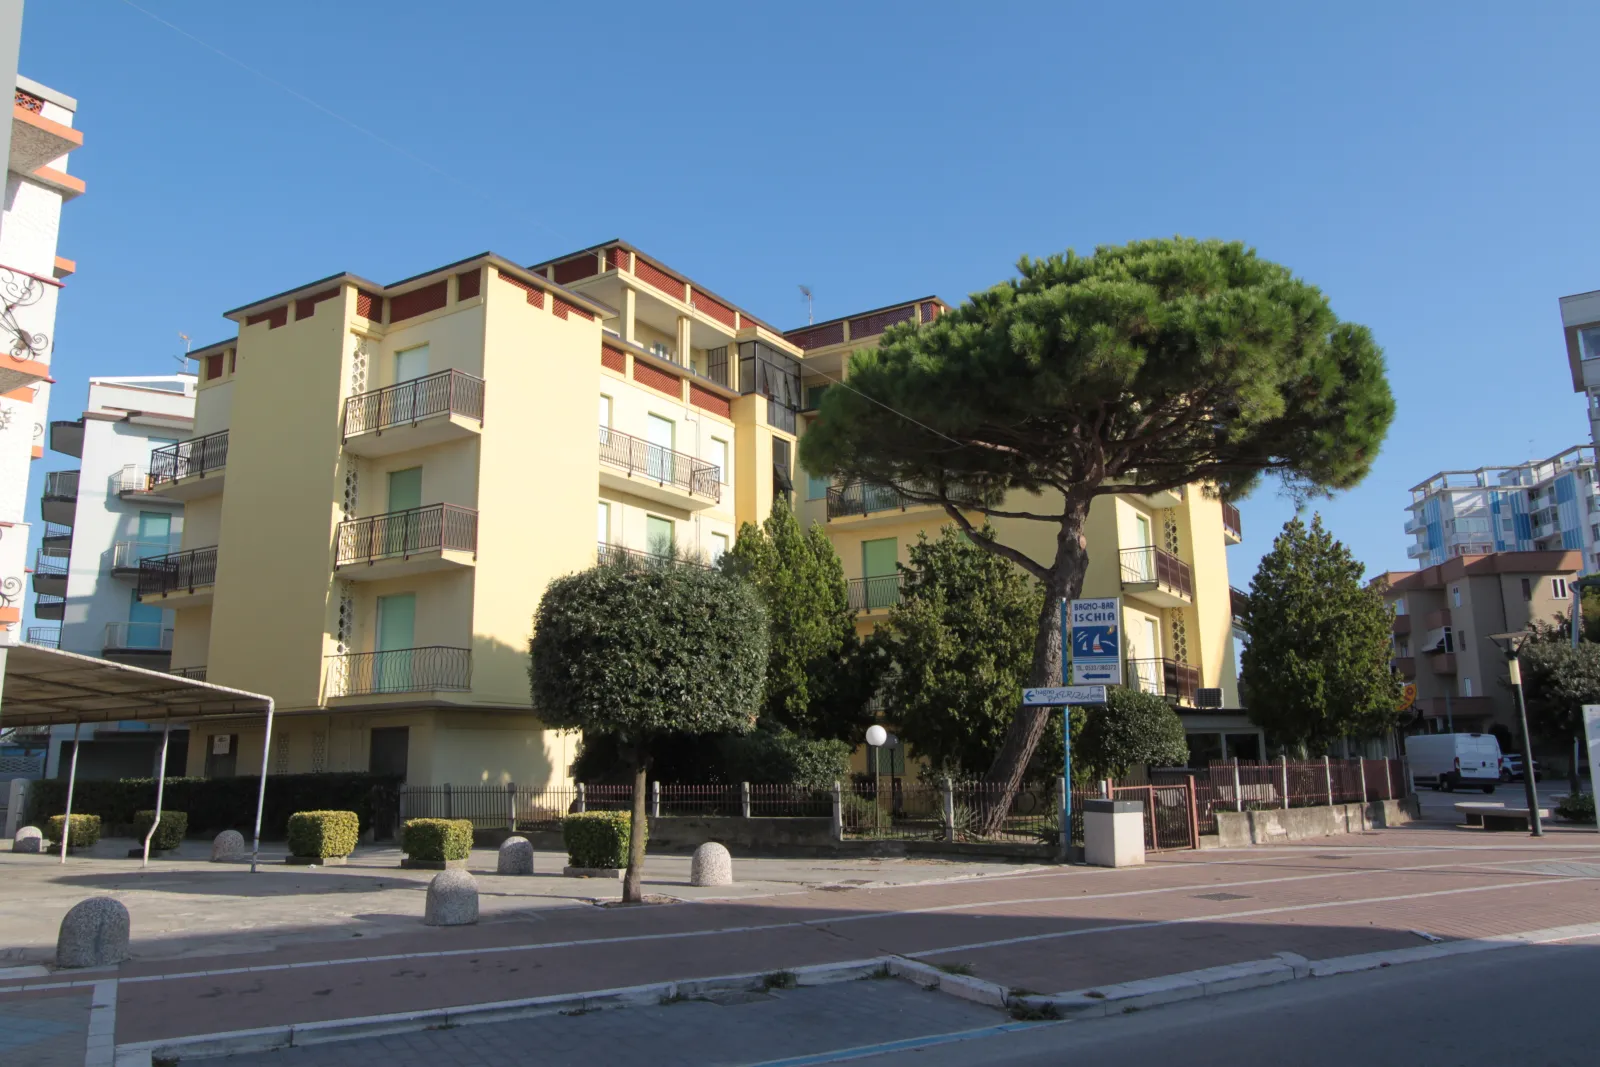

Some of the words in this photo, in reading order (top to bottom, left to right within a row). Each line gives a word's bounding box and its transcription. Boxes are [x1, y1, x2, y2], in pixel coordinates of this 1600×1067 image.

[1074, 602, 1114, 610] BAGNO-BAR
[1075, 612, 1115, 622] ISCHIA
[1035, 689, 1055, 697] bagno
